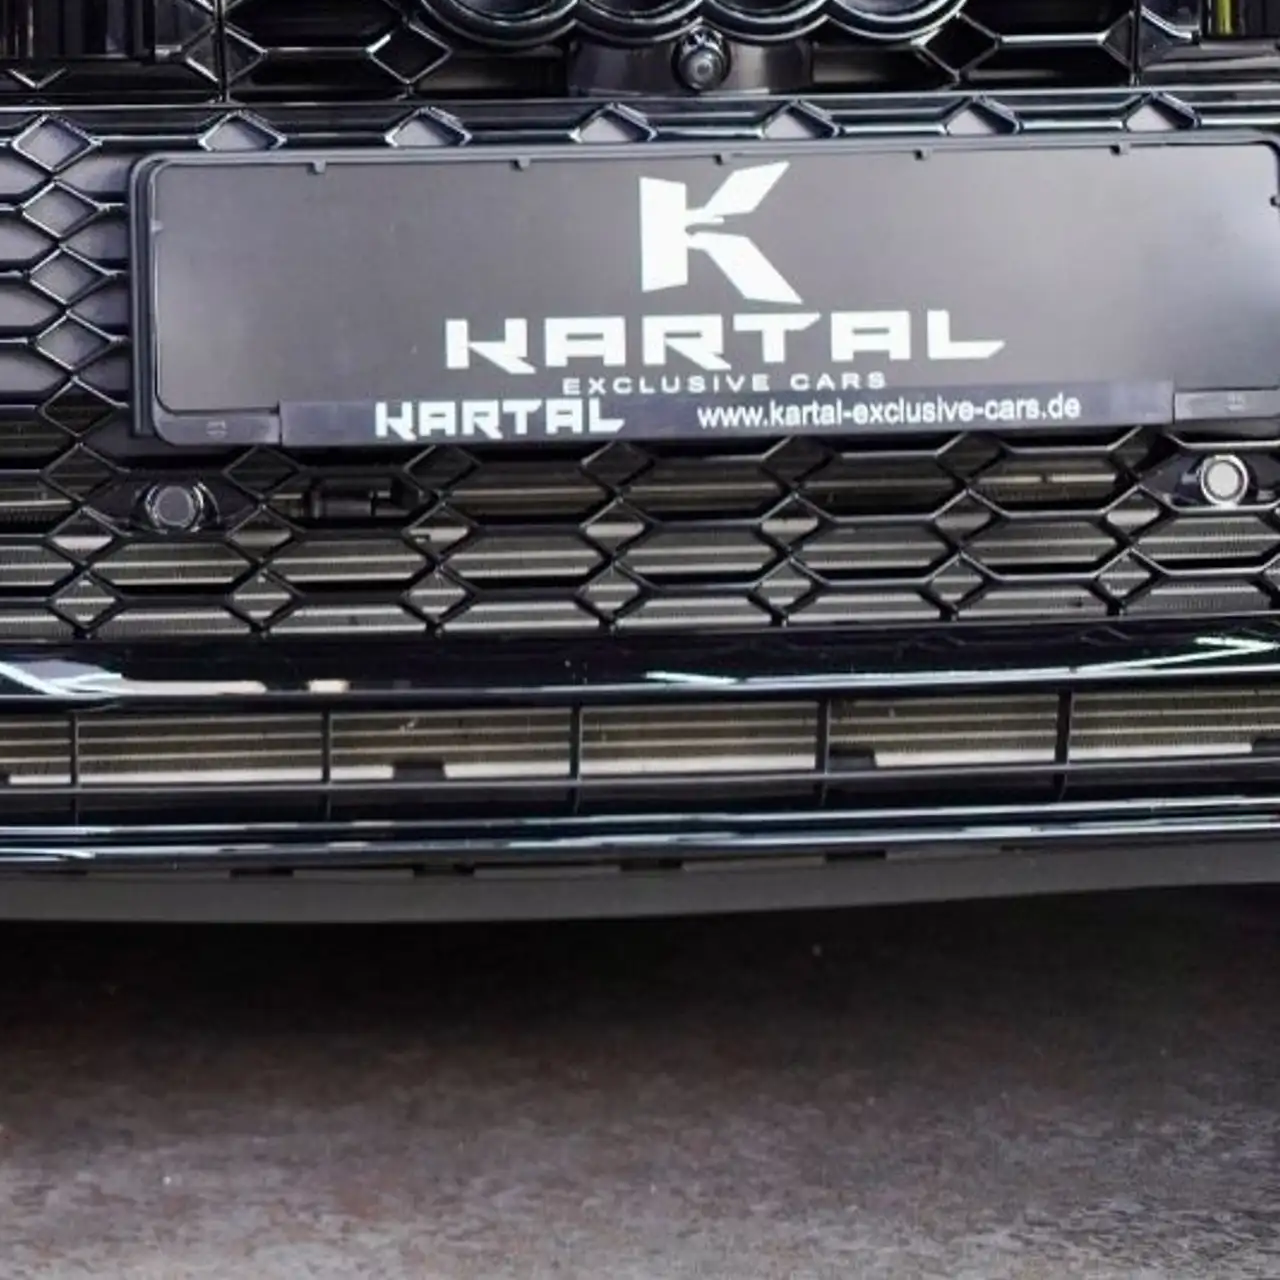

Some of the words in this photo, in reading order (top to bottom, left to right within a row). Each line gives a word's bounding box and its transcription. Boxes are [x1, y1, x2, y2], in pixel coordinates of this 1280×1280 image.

[638, 161, 804, 305] K
[445, 310, 1006, 374] KARTAL
[561, 372, 771, 396] EXCLUSIVE
[789, 371, 888, 392] CARS
[374, 397, 626, 442] KARTAL
[696, 392, 1082, 429] www.kartal-exclusive-cars.de
